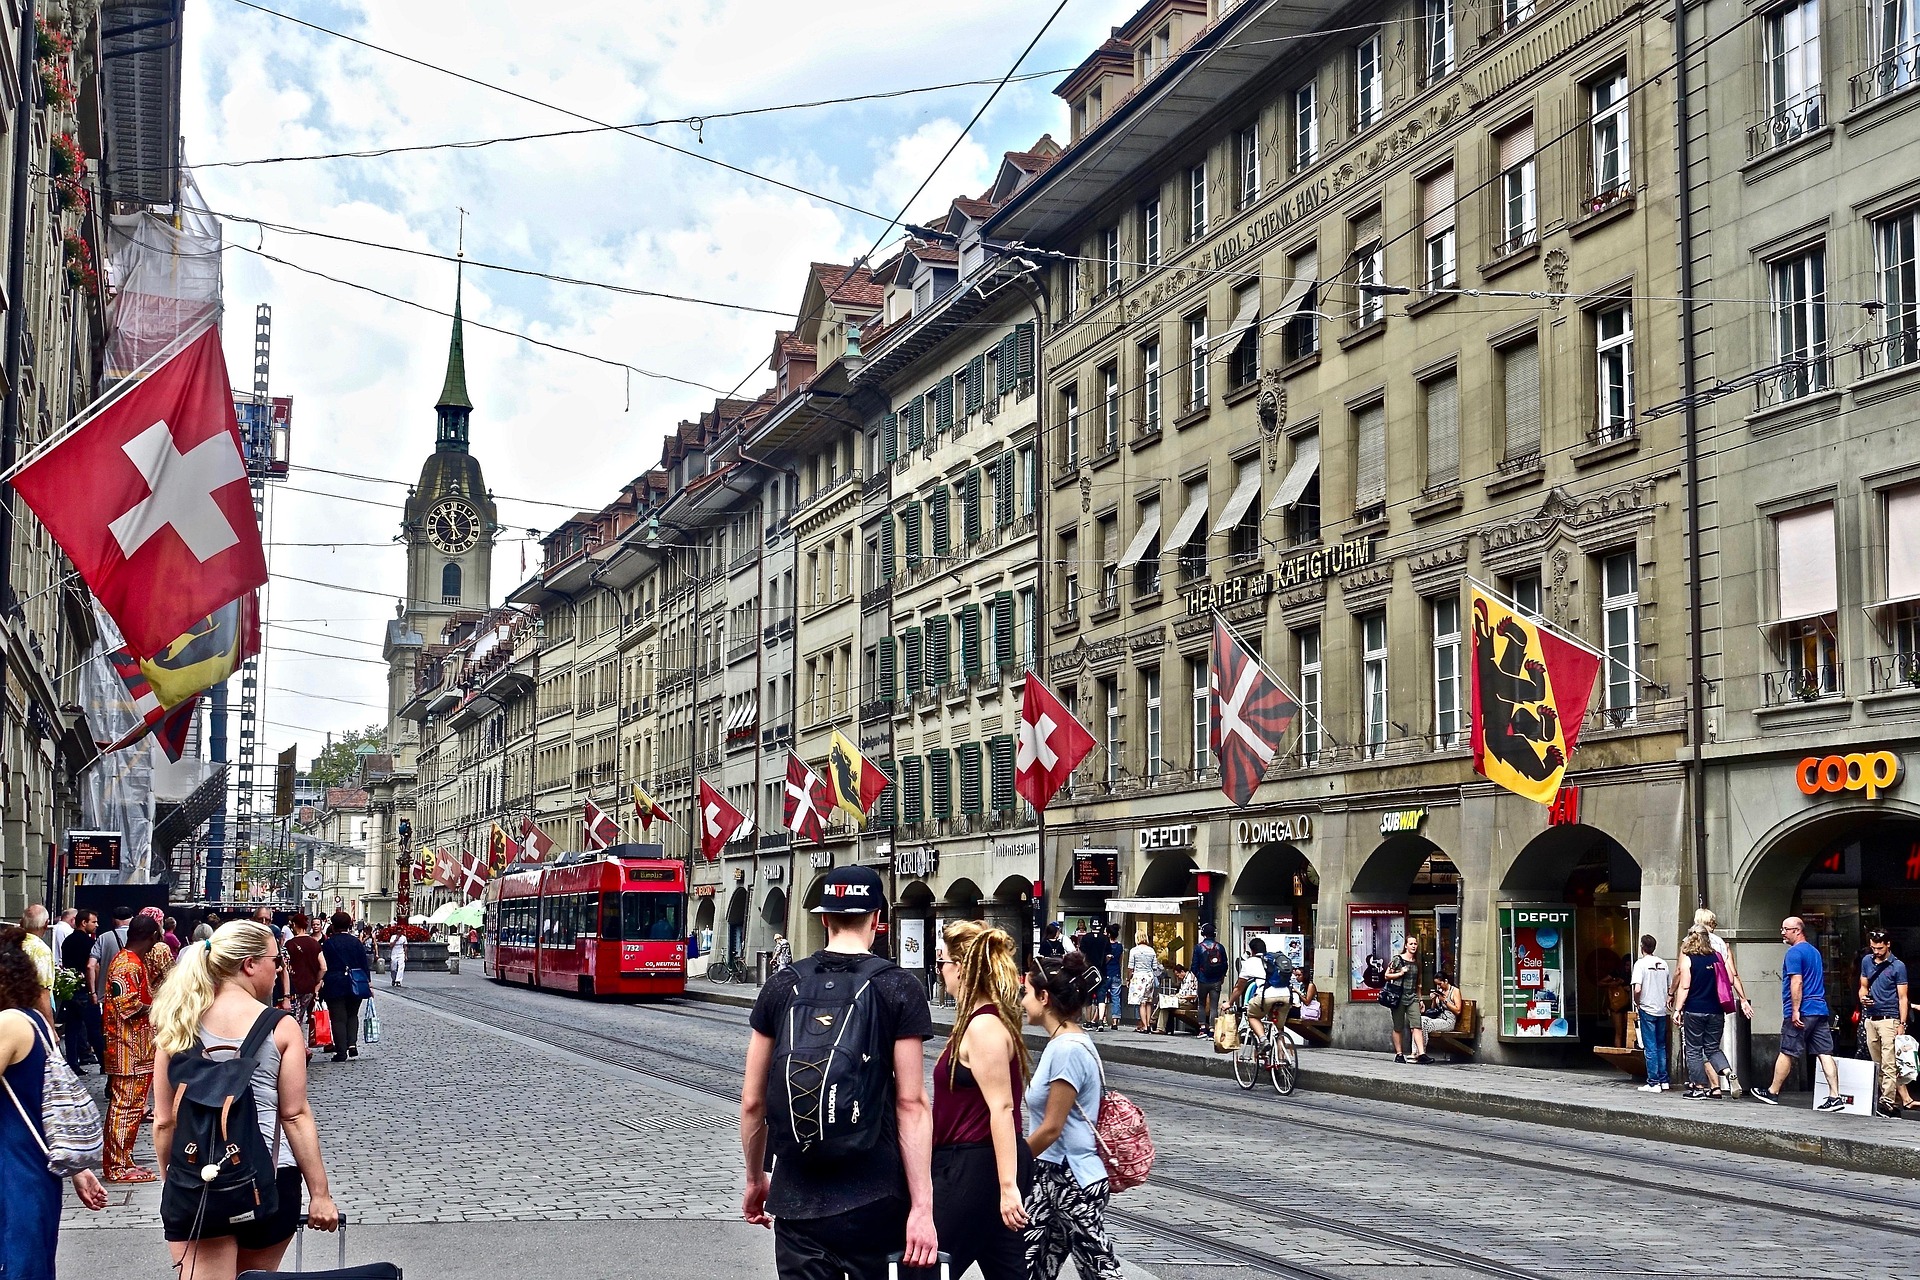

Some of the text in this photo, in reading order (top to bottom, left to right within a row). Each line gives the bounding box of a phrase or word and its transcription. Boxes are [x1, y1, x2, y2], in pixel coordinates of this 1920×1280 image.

[1183, 536, 1369, 616] THEATER AM KÄFIGTURM
[1795, 750, 1899, 800] coop
[1250, 820, 1293, 843] OMEGA
[1380, 808, 1424, 832] SUBWAY
[1139, 824, 1193, 849] DEPOT
[1518, 912, 1569, 922] DEPOT
[626, 944, 640, 952] 732
[1523, 957, 1542, 967] Sale
[1521, 973, 1540, 982] 50%
[828, 1083, 838, 1124] DIADORA
